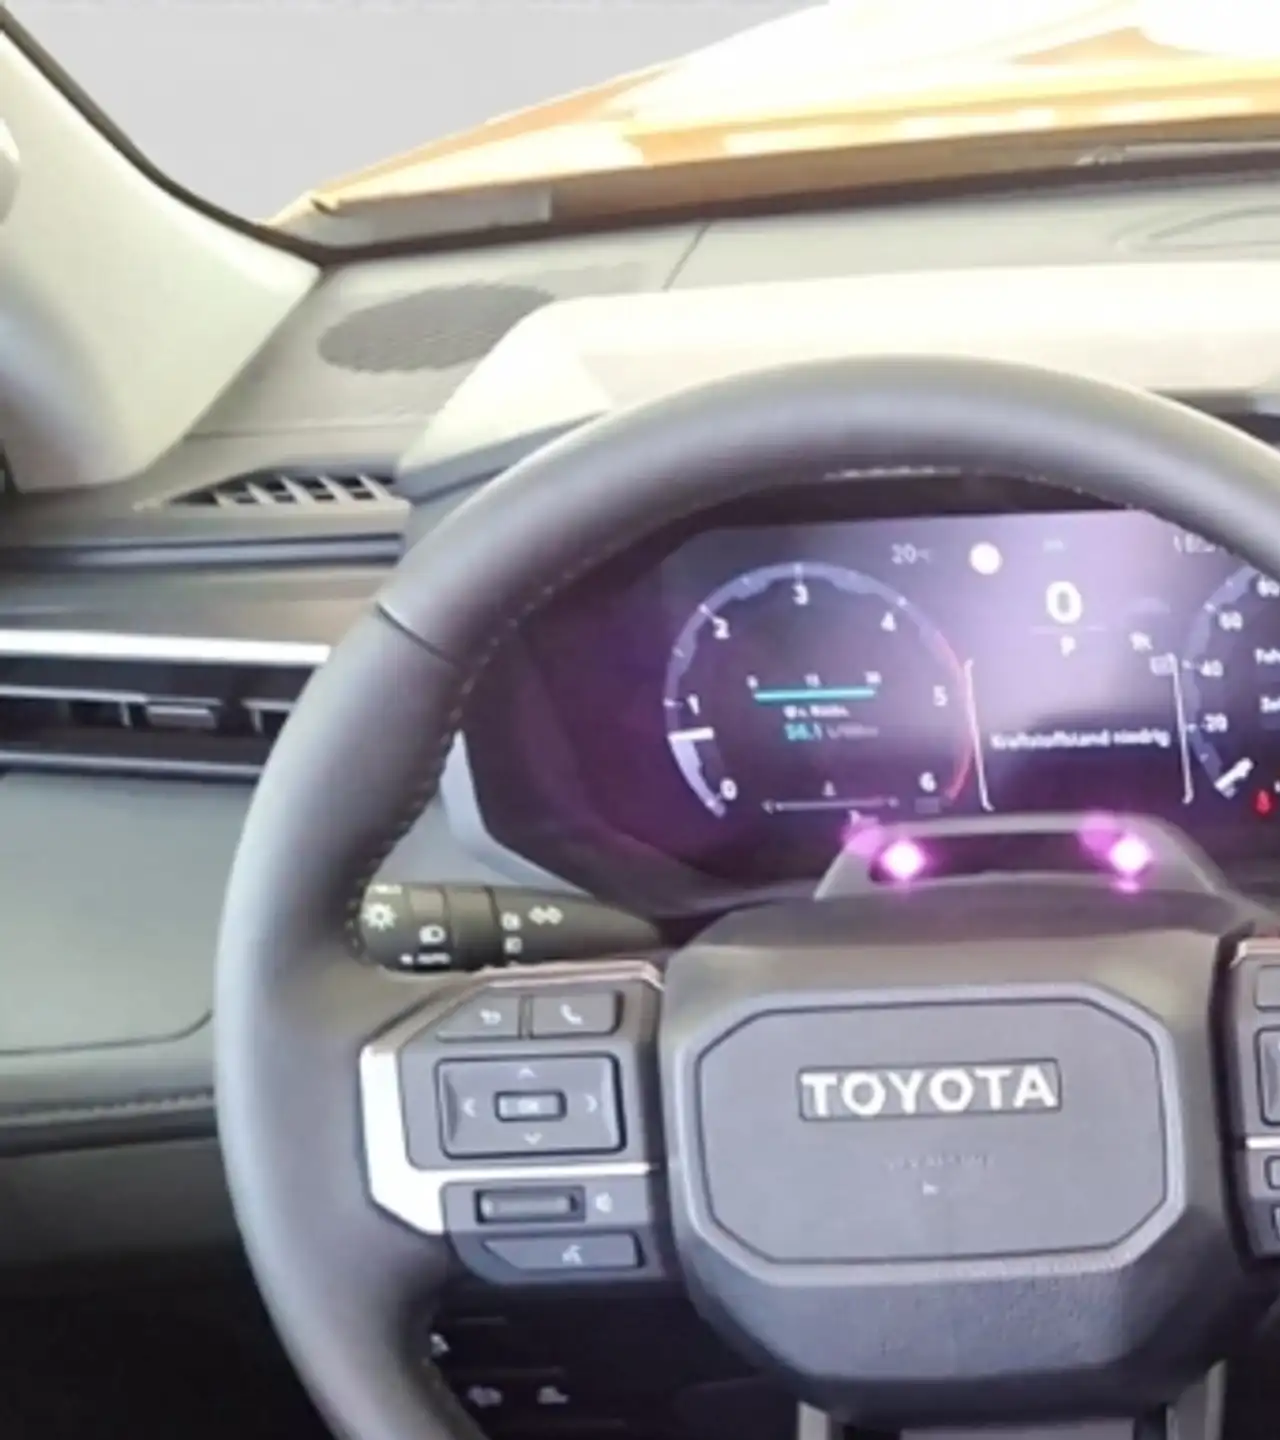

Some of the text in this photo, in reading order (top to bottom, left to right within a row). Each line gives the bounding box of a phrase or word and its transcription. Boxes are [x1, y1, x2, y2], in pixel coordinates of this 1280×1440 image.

[792, 584, 809, 605] 3
[1046, 580, 1082, 624] 0
[713, 618, 731, 639] 2
[880, 612, 896, 631] 4
[933, 687, 947, 706] 5
[720, 779, 738, 800] 0
[919, 773, 936, 792] 6
[801, 1063, 1058, 1117] TOYOTA
